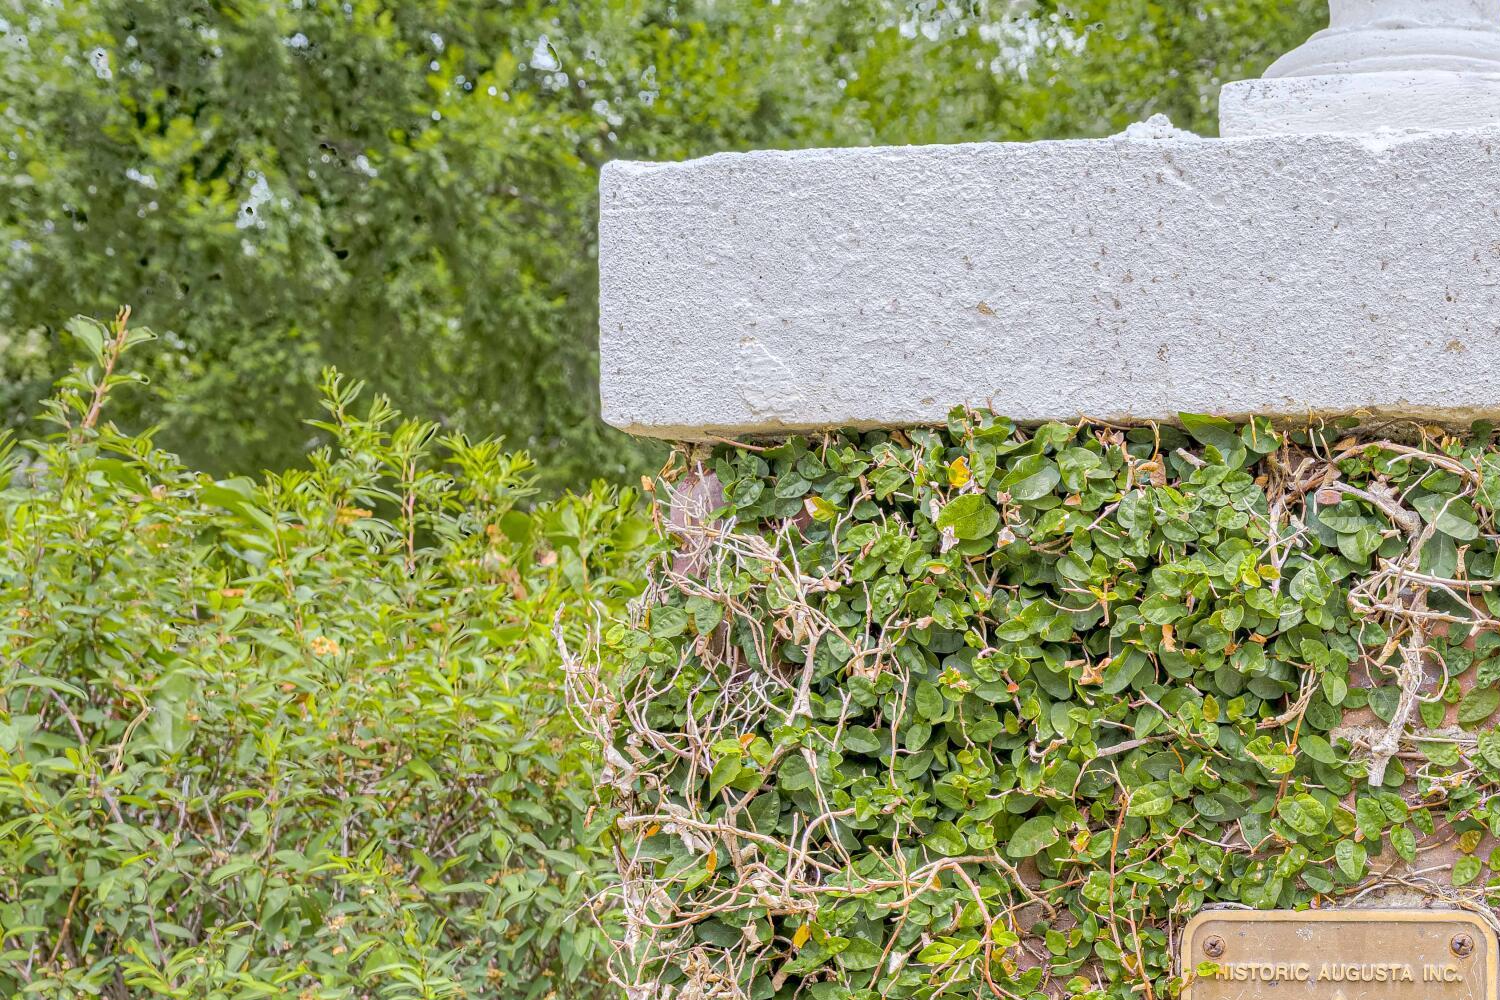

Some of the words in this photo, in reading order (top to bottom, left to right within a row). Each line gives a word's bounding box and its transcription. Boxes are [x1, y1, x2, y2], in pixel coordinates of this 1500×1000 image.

[1215, 963, 1310, 981] HISTORIC
[1317, 963, 1414, 982] AUGUSTA
[1423, 964, 1463, 982] INC.
